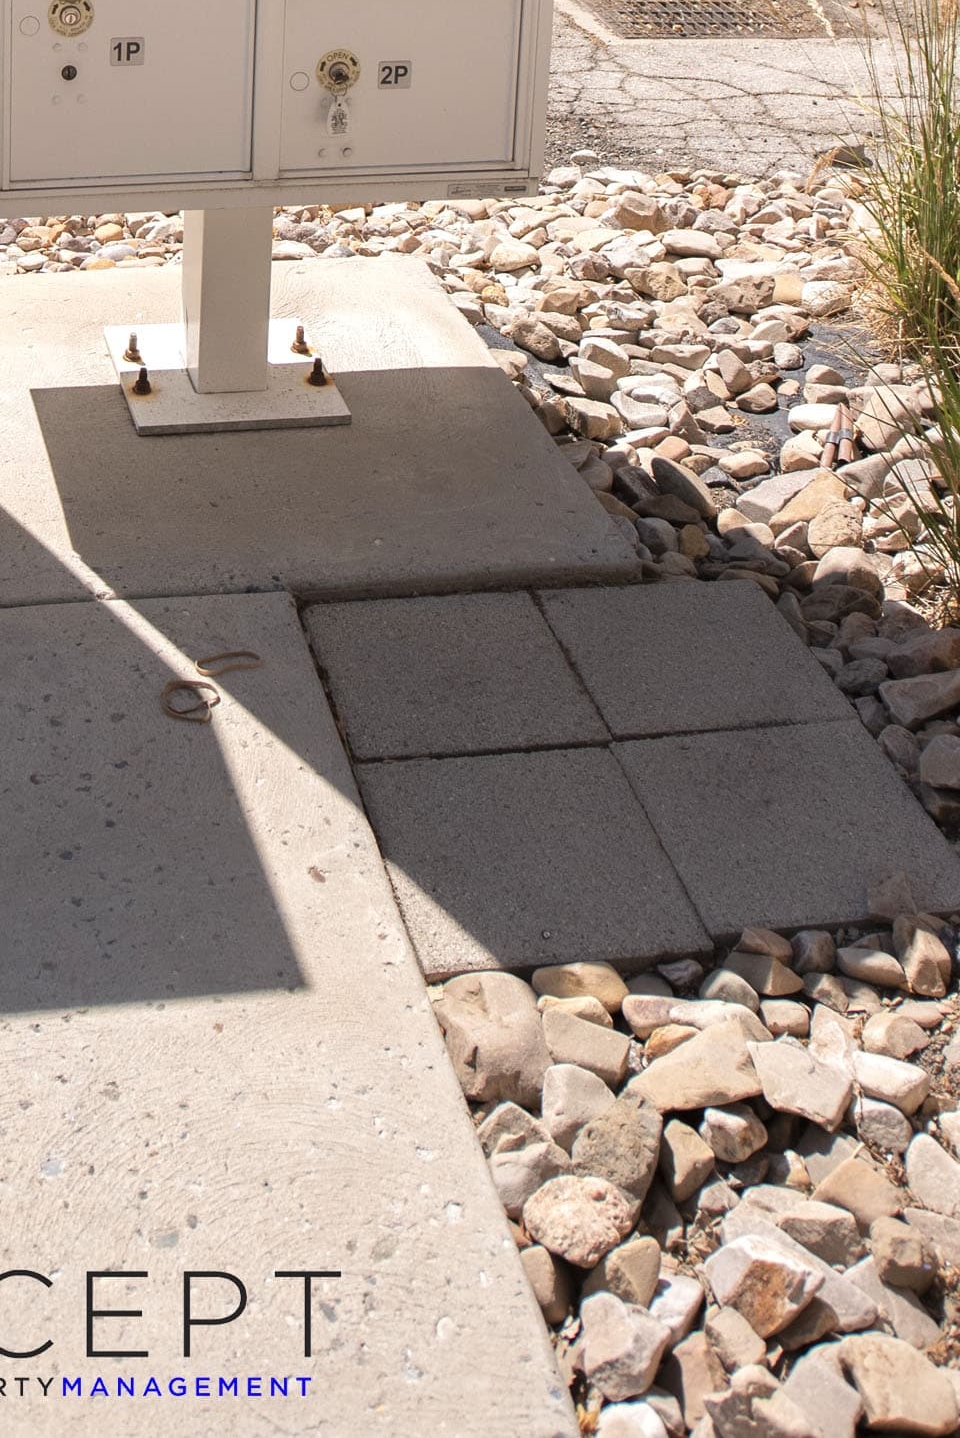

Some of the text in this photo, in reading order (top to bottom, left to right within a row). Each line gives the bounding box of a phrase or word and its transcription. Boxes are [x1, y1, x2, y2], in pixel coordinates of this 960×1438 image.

[113, 41, 141, 62] 1P
[327, 52, 349, 62] OPEN
[380, 65, 408, 85] 2P
